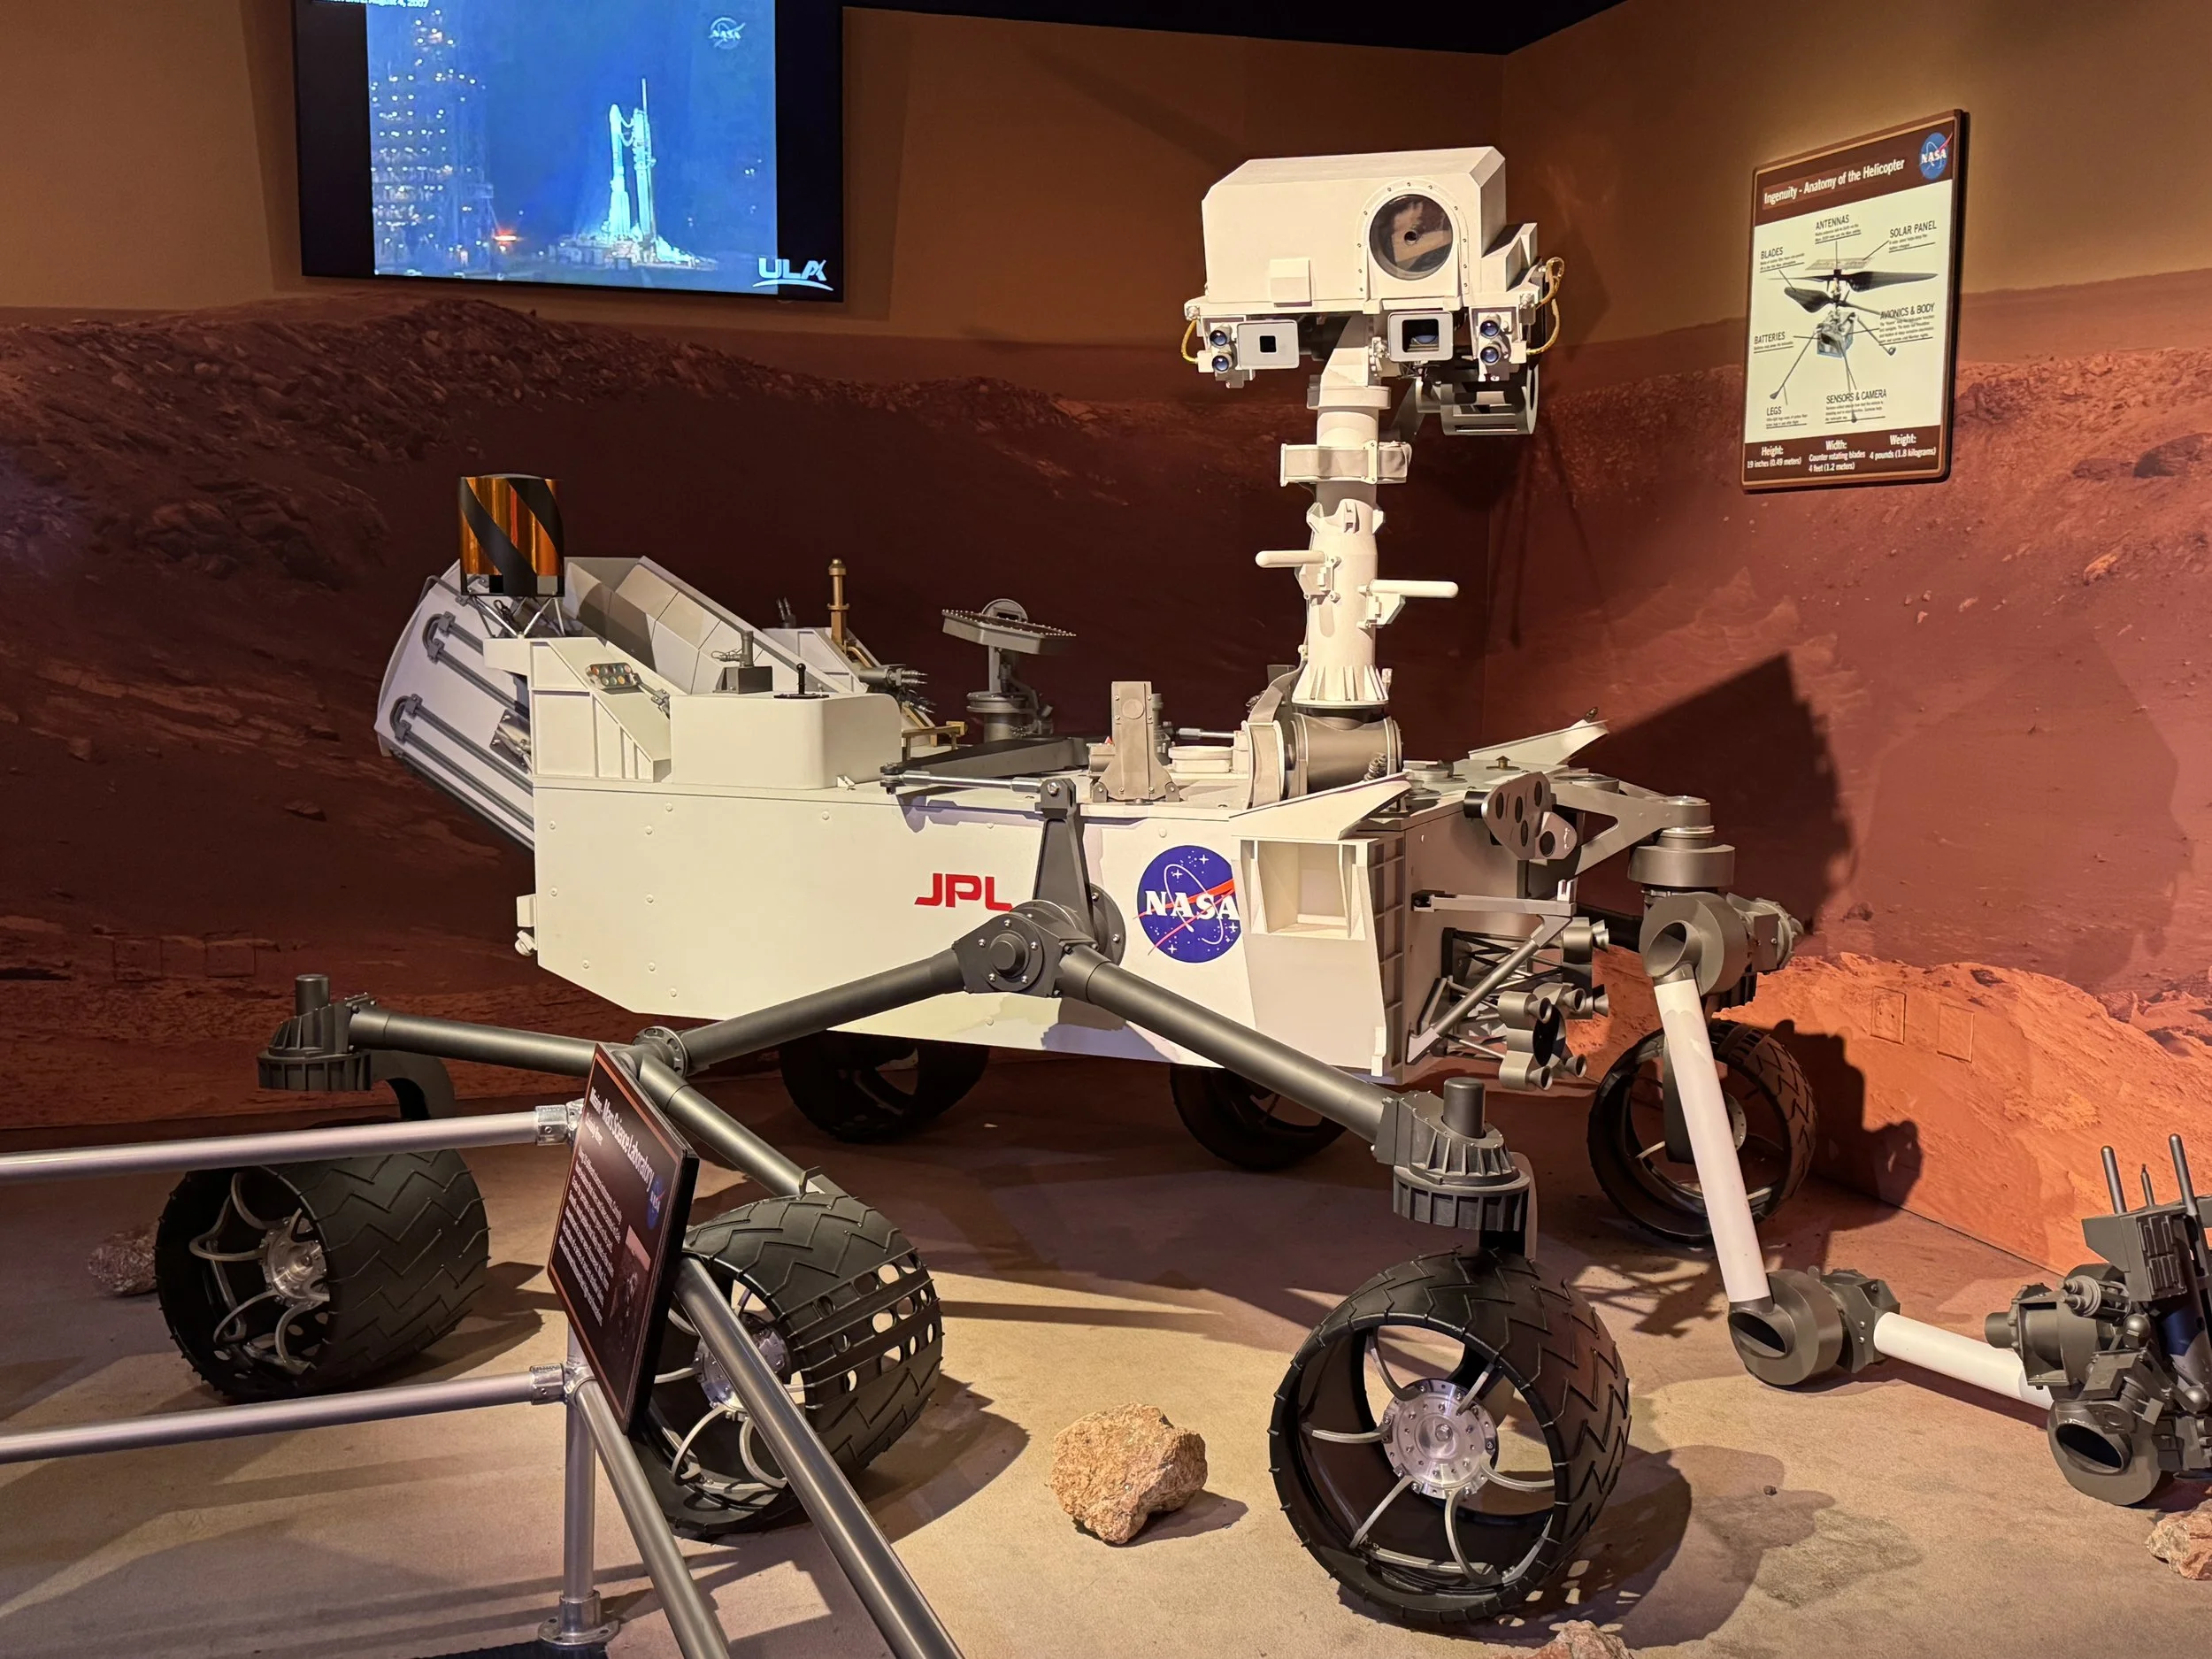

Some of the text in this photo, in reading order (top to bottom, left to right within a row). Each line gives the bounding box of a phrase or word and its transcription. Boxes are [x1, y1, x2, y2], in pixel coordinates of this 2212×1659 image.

[1921, 148, 1947, 165] NASA
[1764, 186, 1797, 204] Ingenuity
[1803, 180, 1836, 195] Anatomy
[1838, 172, 1847, 184] of
[1848, 169, 1861, 182] the
[1863, 158, 1905, 179] Helicopter
[1816, 214, 1849, 230] ANTENNAS
[1889, 220, 1937, 238] SOLAR PANEL
[1761, 247, 1783, 259] BLADES
[758, 257, 826, 280] ULA
[1916, 303, 1935, 314] BODY
[1754, 332, 1786, 344] BATTERIES
[1826, 393, 1854, 404] SENSORS
[1861, 389, 1887, 400] CAMERA
[1766, 406, 1782, 416] LEGS
[1825, 440, 1847, 451] Width:
[1890, 434, 1916, 447] Weight:
[1761, 445, 1784, 457] Height:
[1809, 450, 1866, 462] Counter rotating blades
[914, 873, 1013, 911] JPL
[1145, 890, 1239, 920] NASA
[602, 1098, 614, 1133] Mars
[613, 1112, 630, 1152] Science
[627, 1134, 655, 1192] Laboratory
